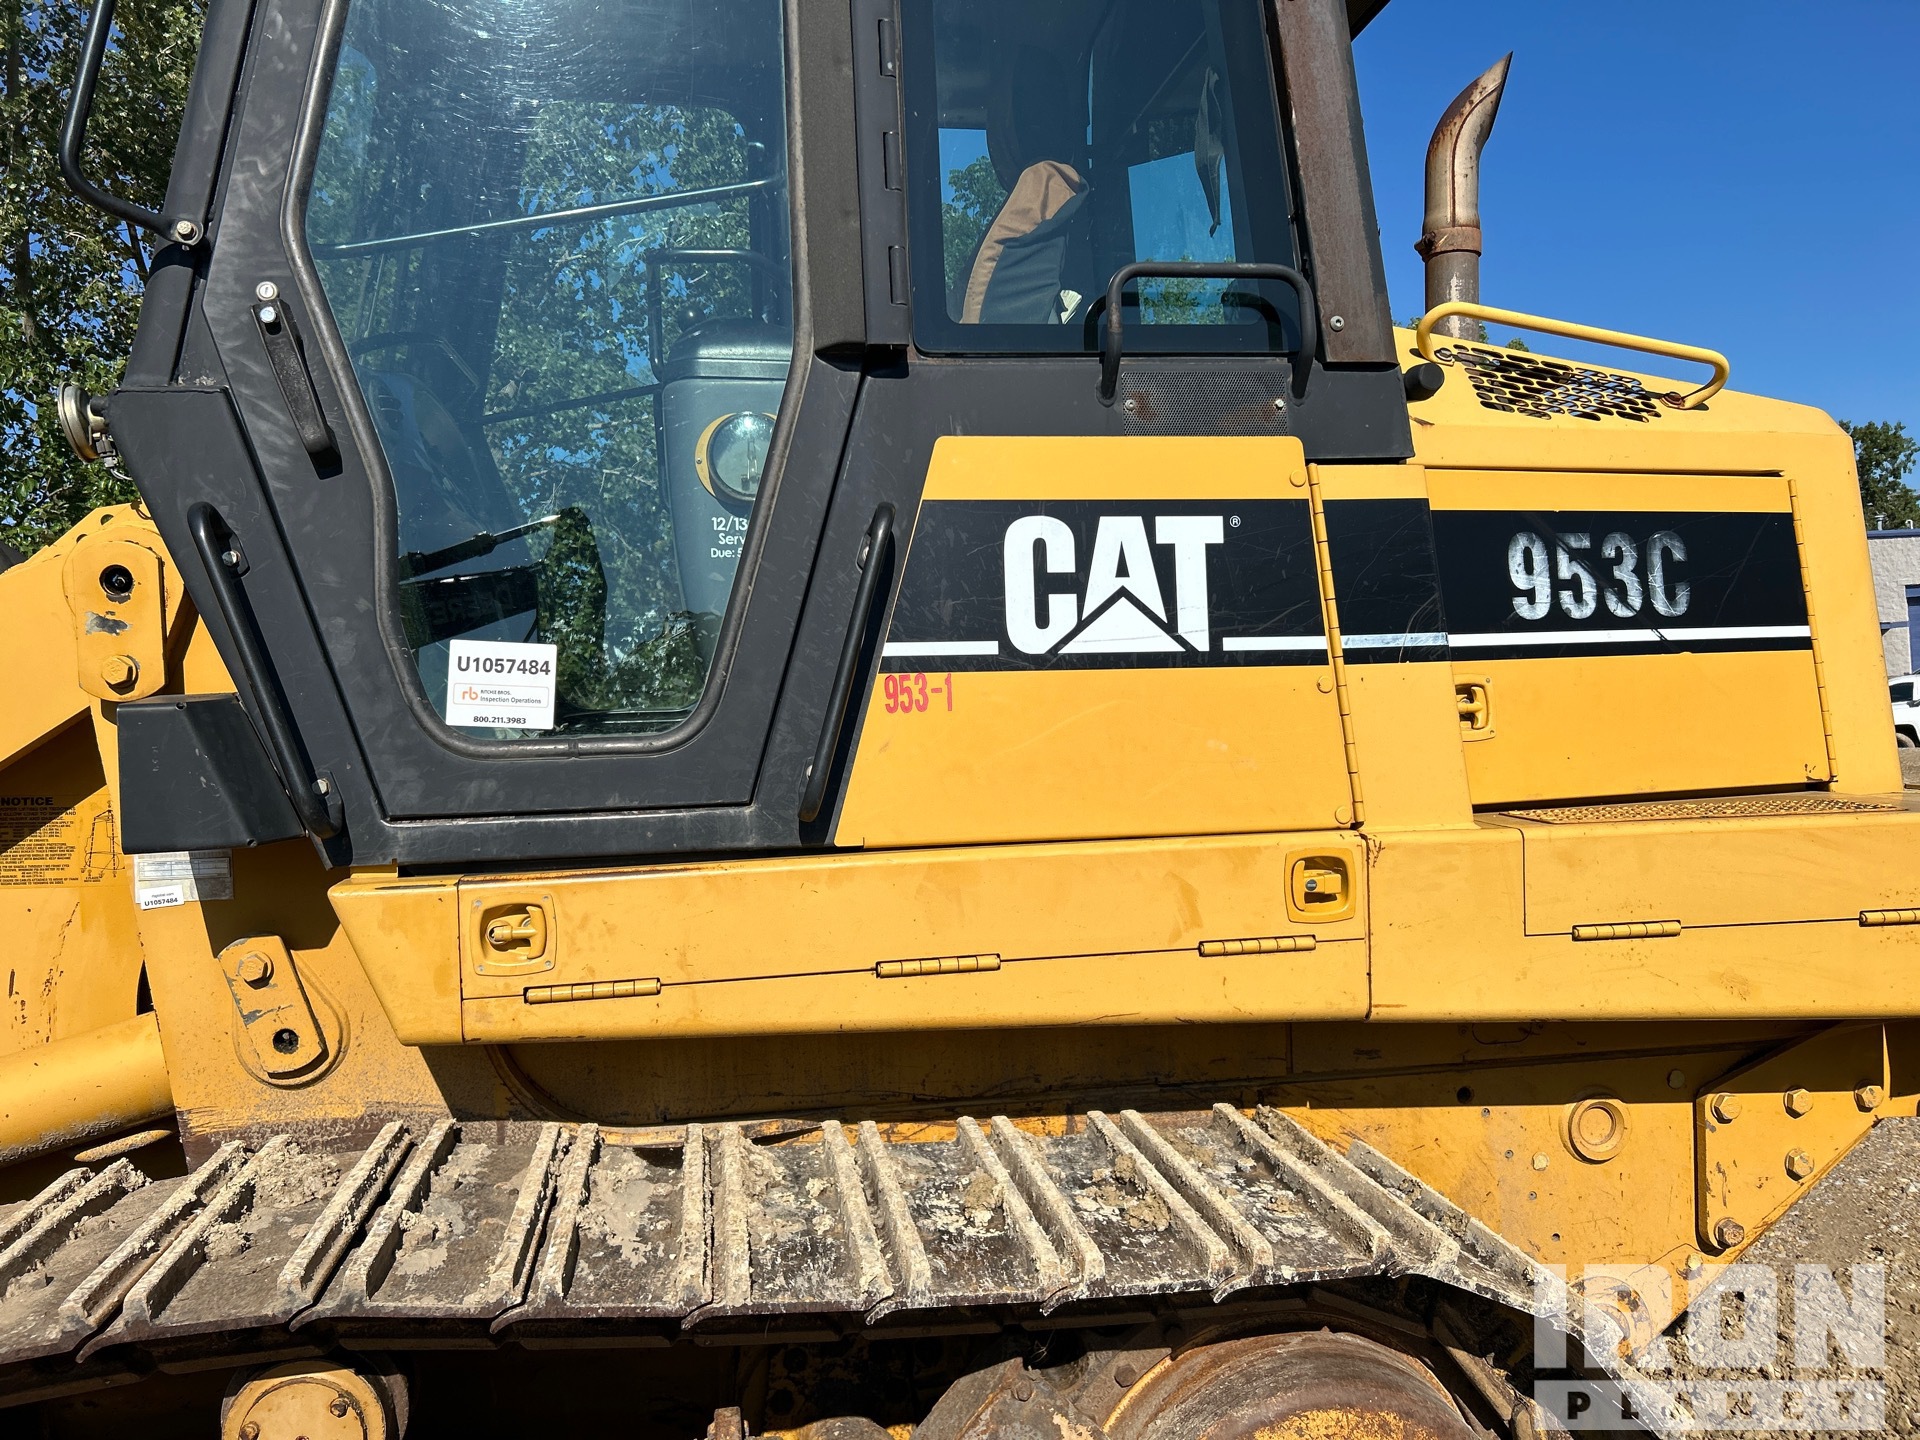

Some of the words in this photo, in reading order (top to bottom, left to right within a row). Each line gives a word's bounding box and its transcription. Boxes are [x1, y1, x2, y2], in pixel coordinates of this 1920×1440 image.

[710, 548, 735, 558] Due:
[1507, 530, 1691, 620] 953C
[1003, 515, 1225, 655] CAT
[457, 656, 551, 676] U1057484
[462, 686, 479, 701] rb
[884, 673, 953, 714] 953-1
[480, 696, 510, 704] Inspection
[511, 697, 541, 705] Operations
[473, 716, 526, 724] 800.211.3983
[1, 797, 54, 806] NOTICE
[144, 897, 178, 907] U1057484
